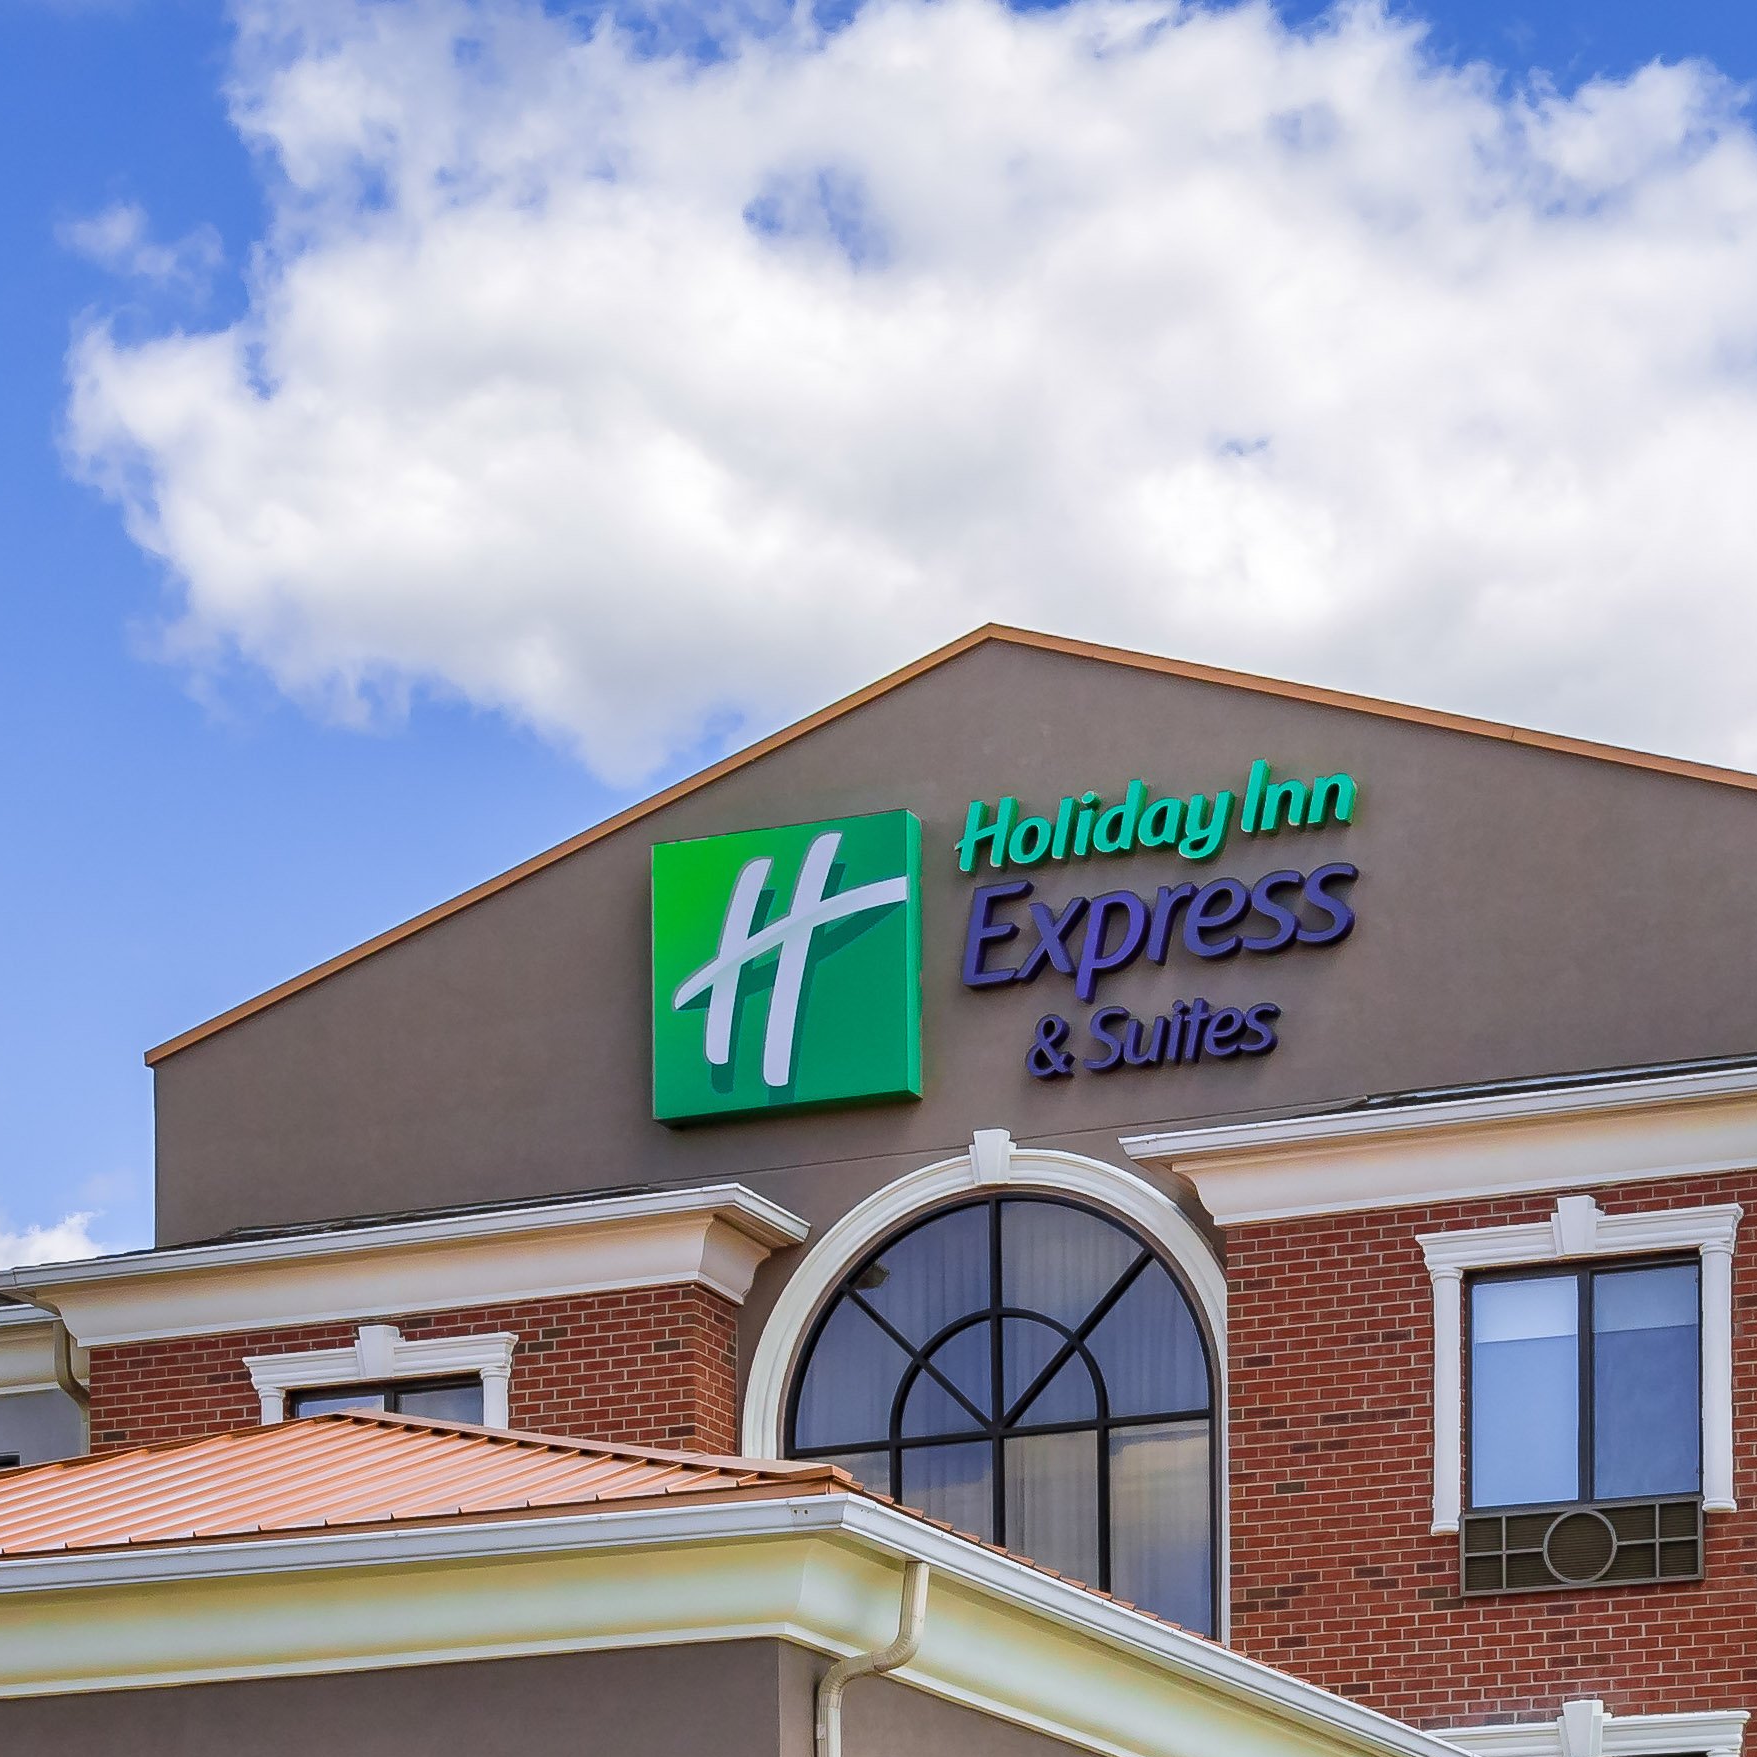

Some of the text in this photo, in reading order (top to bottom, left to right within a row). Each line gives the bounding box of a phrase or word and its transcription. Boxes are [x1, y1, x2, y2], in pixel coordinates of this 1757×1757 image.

[954, 758, 1358, 874] Holiday Inn
[962, 862, 1360, 1001] Express
[1026, 997, 1282, 1078] & Suites
